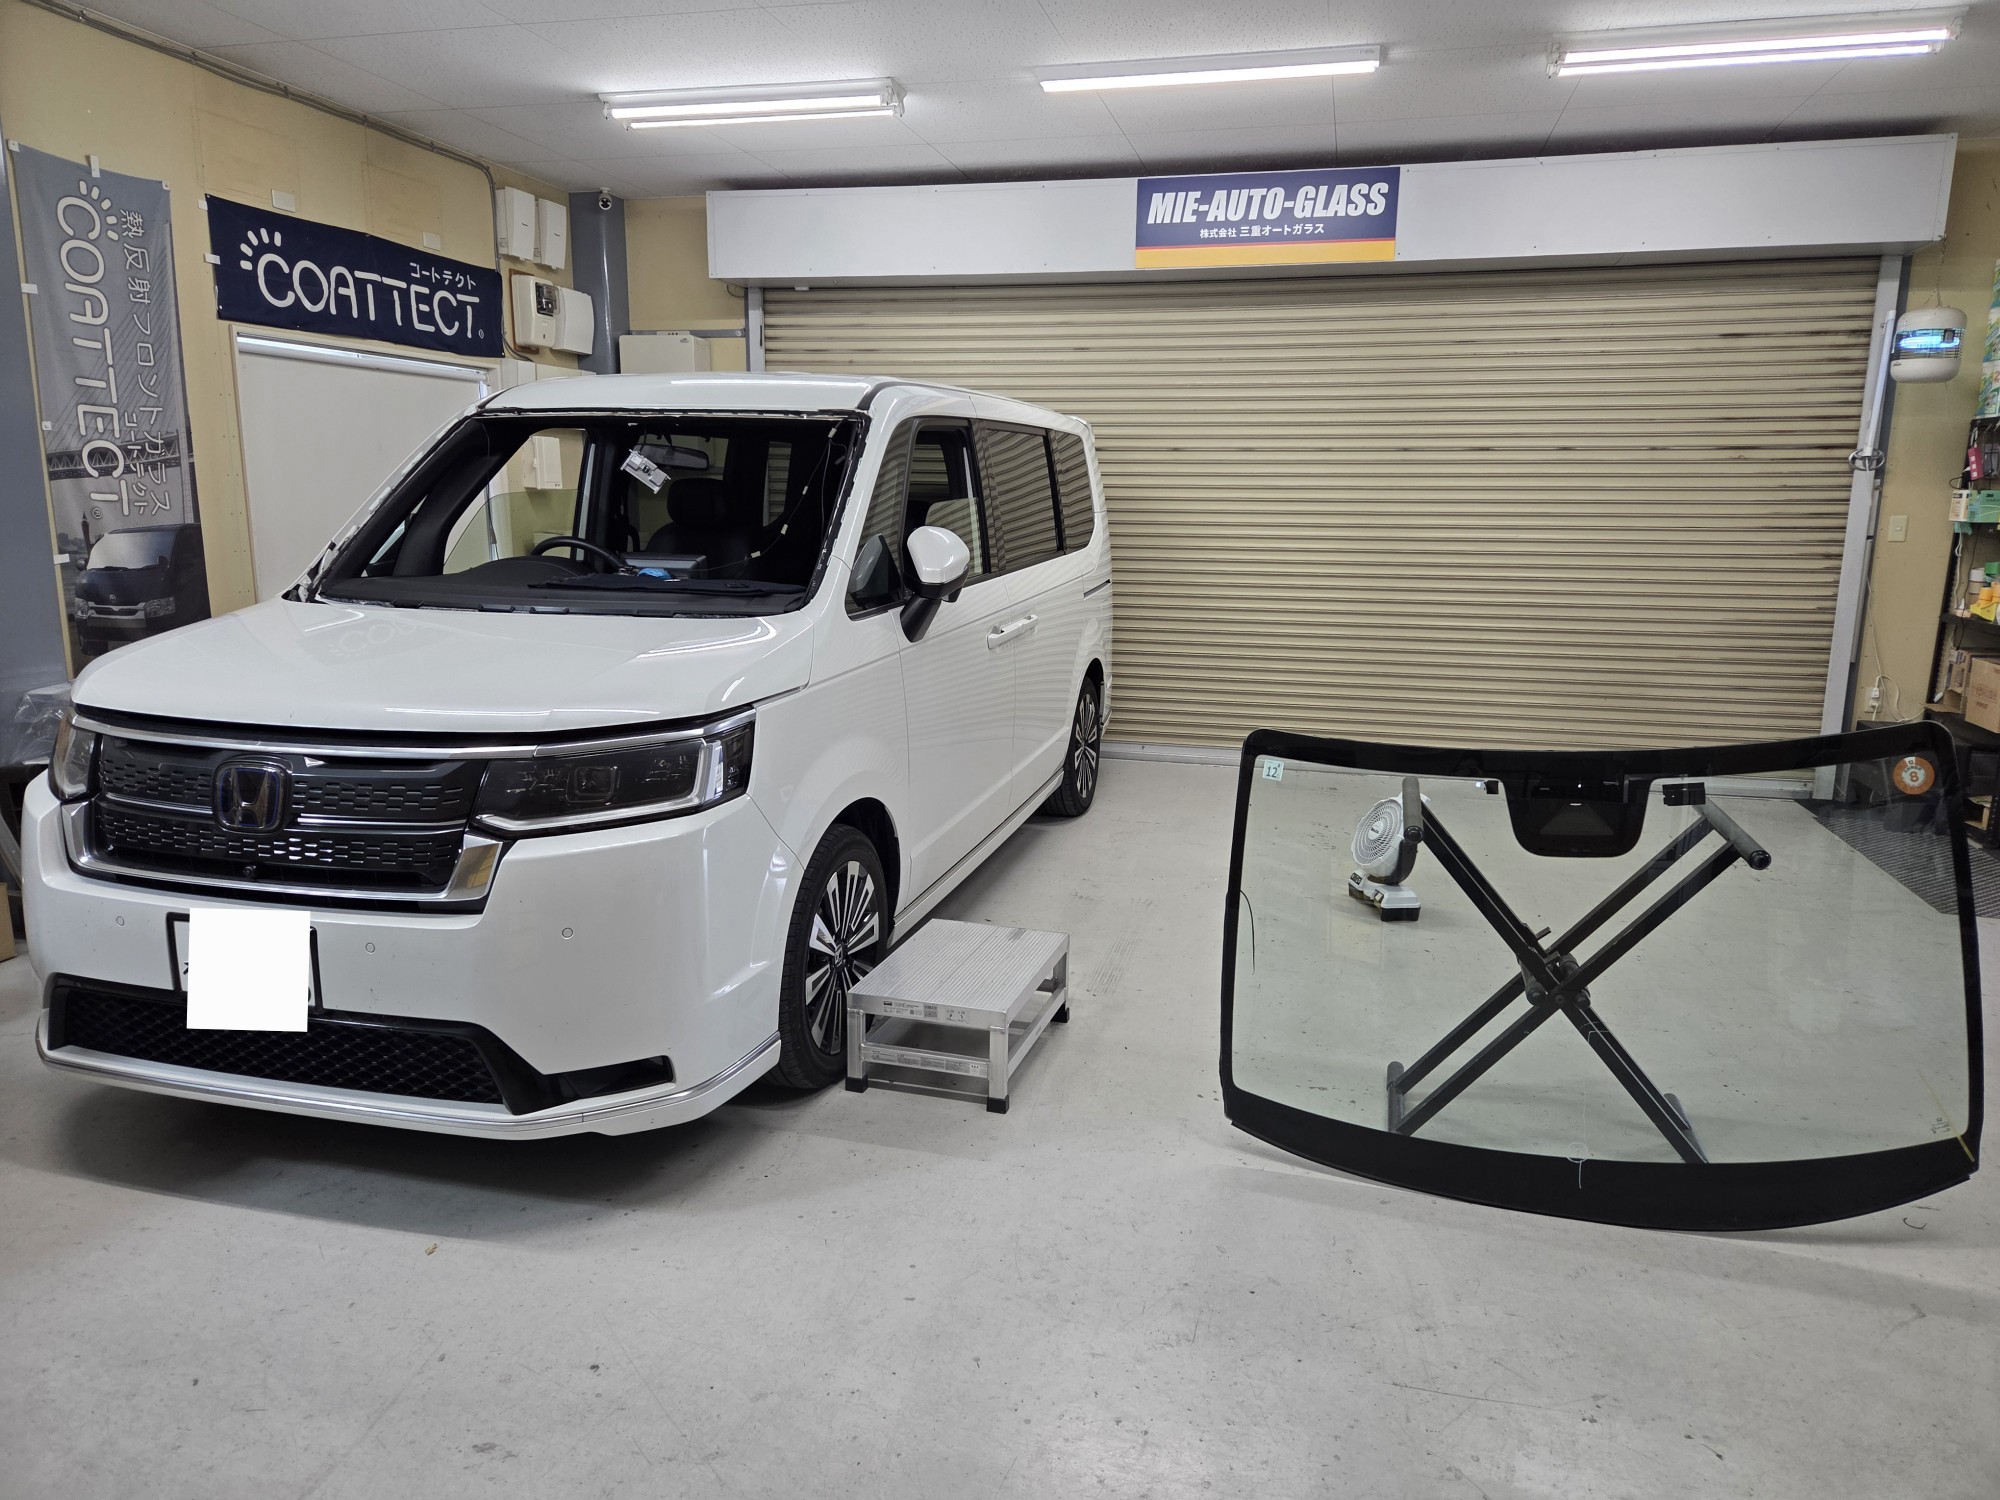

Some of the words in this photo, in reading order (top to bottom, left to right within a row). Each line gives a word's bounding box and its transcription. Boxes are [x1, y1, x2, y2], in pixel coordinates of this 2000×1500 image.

[1147, 182, 1388, 224] MIE-AUTO-GLASS
[1199, 228, 1237, 239] 株式会社
[1240, 223, 1325, 237] 三重オートガラス
[257, 253, 480, 339] COATTECT
[410, 262, 477, 290] コートテクト
[57, 196, 130, 516] COATTECT
[119, 209, 171, 515] 熱反射フロントガラス
[124, 411, 149, 515] コートテクト
[1265, 766, 1278, 778] 12
